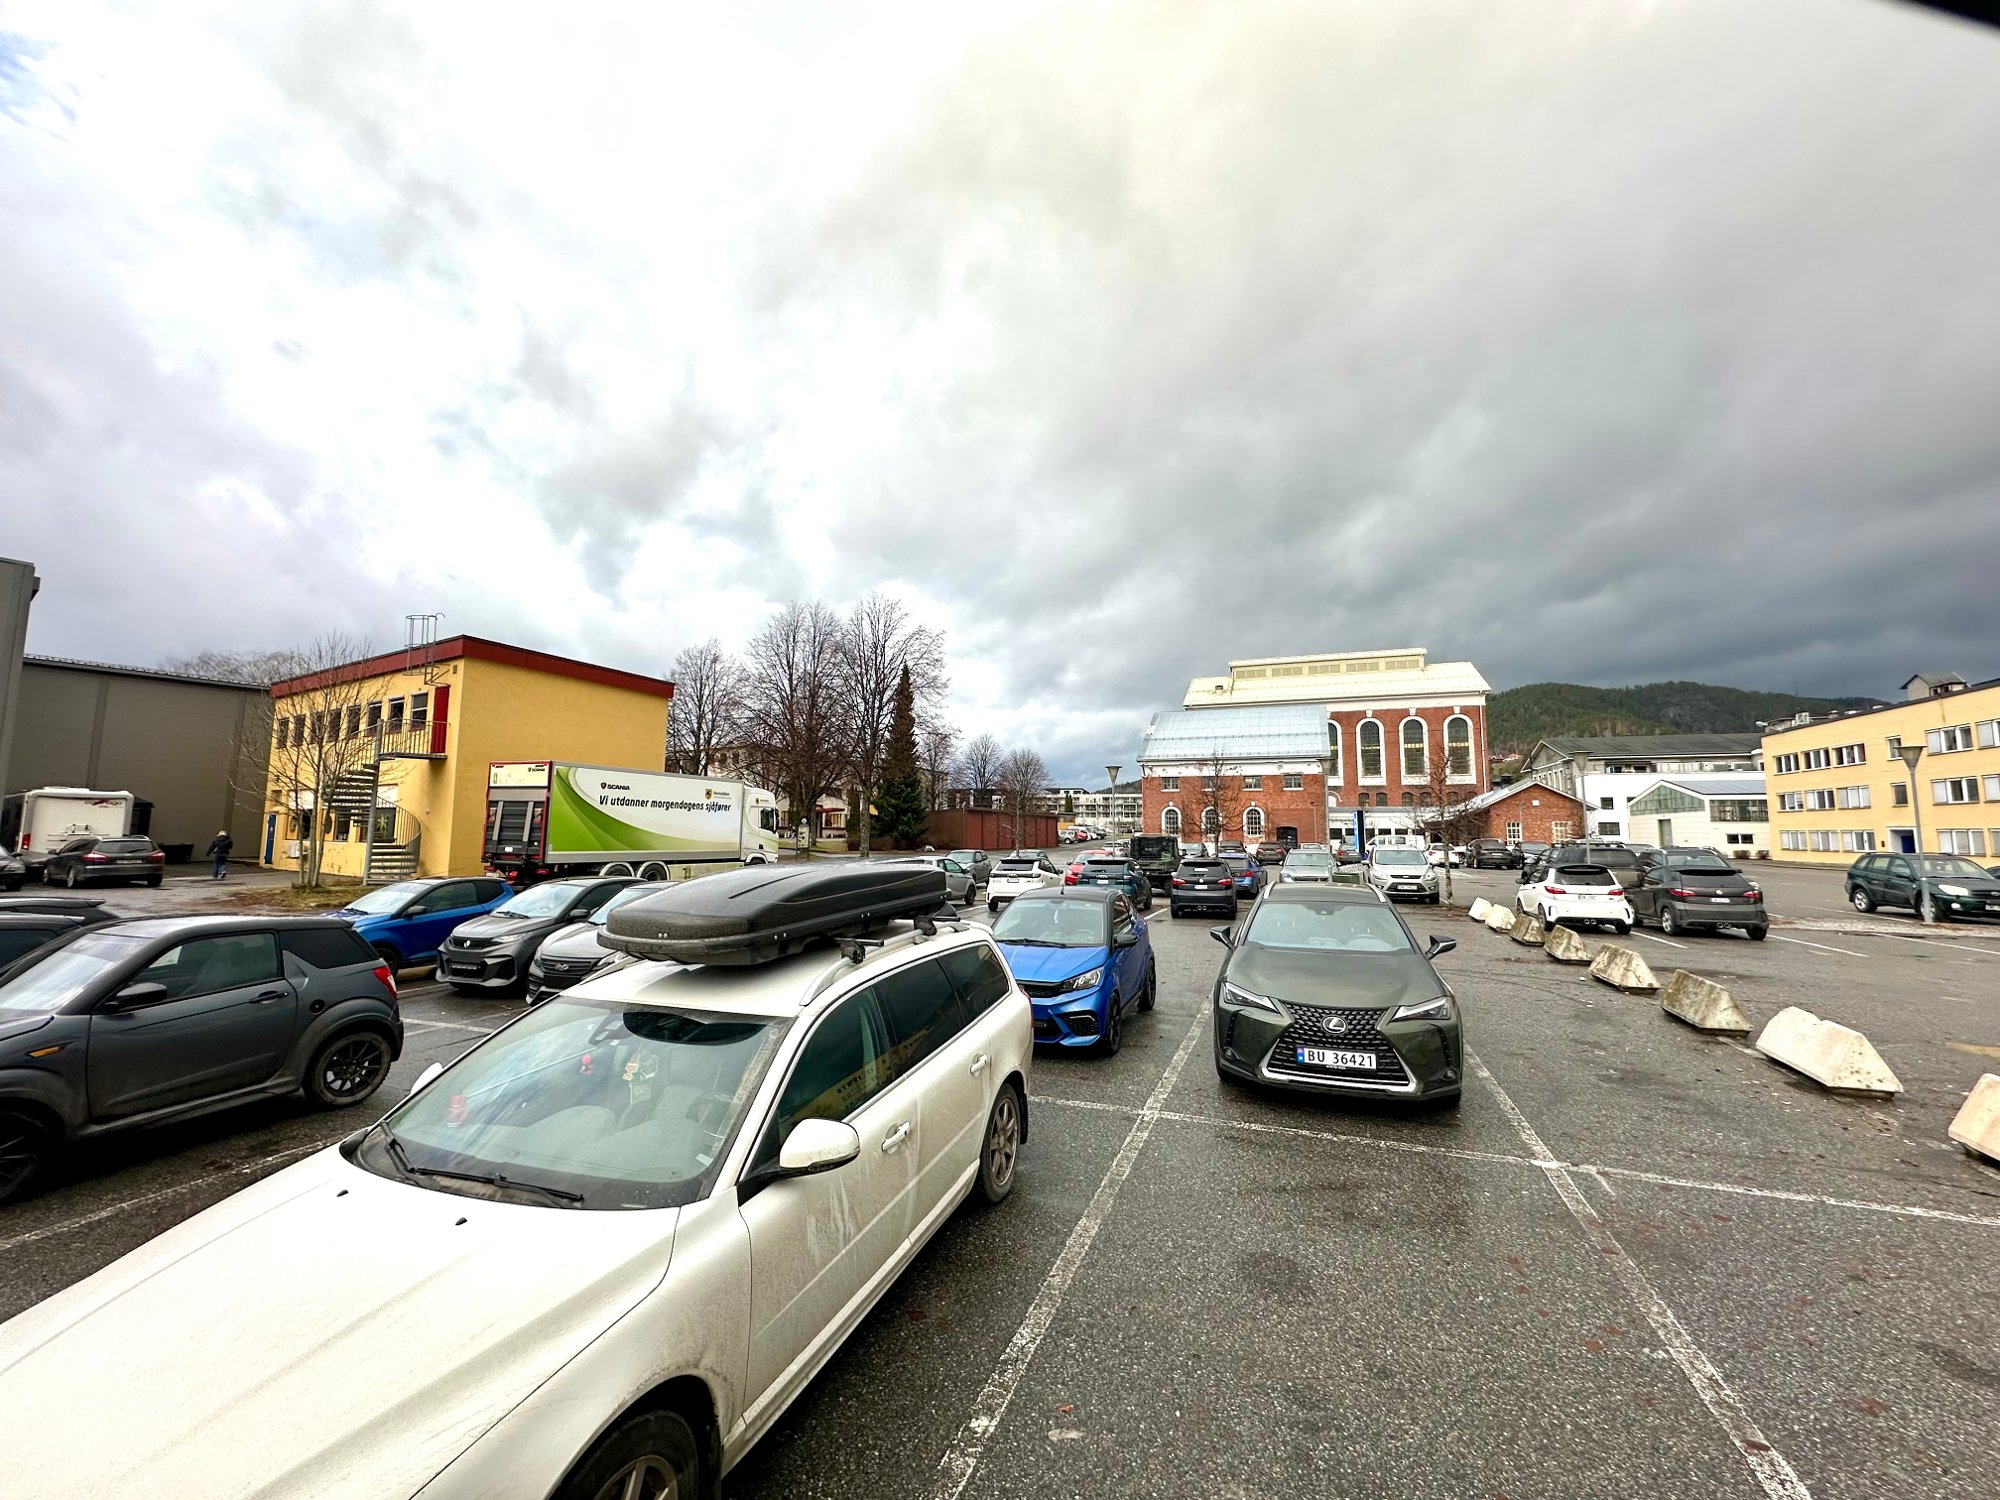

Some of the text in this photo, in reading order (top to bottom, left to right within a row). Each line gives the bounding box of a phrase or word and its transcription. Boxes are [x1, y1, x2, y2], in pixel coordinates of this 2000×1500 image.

[599, 795, 731, 812] Vi utdanner morgendagens sjåfører
[1308, 1050, 1325, 1062] BU
[1333, 1052, 1373, 1067] 36421
